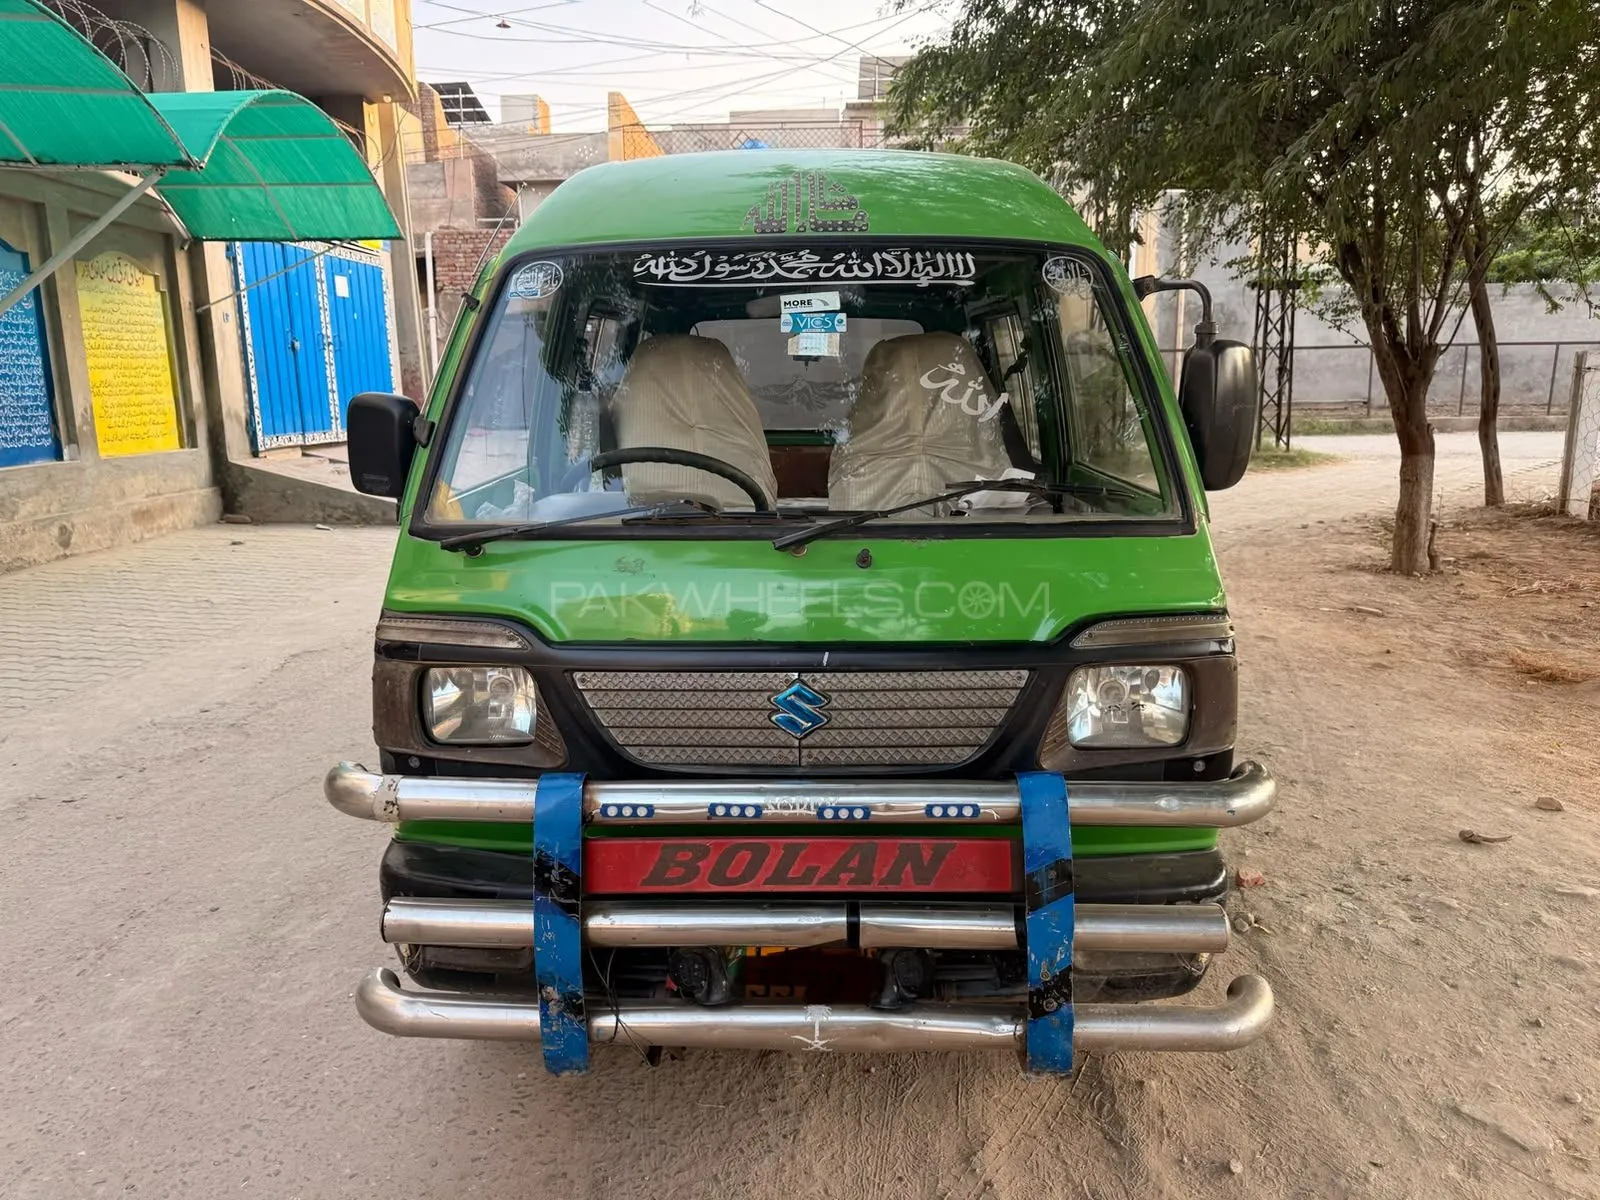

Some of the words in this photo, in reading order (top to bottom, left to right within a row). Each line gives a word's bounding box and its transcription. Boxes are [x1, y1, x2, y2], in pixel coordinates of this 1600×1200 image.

[783, 299, 813, 308] MORE
[796, 317, 832, 329] VICS
[638, 841, 958, 888] BOLAN
